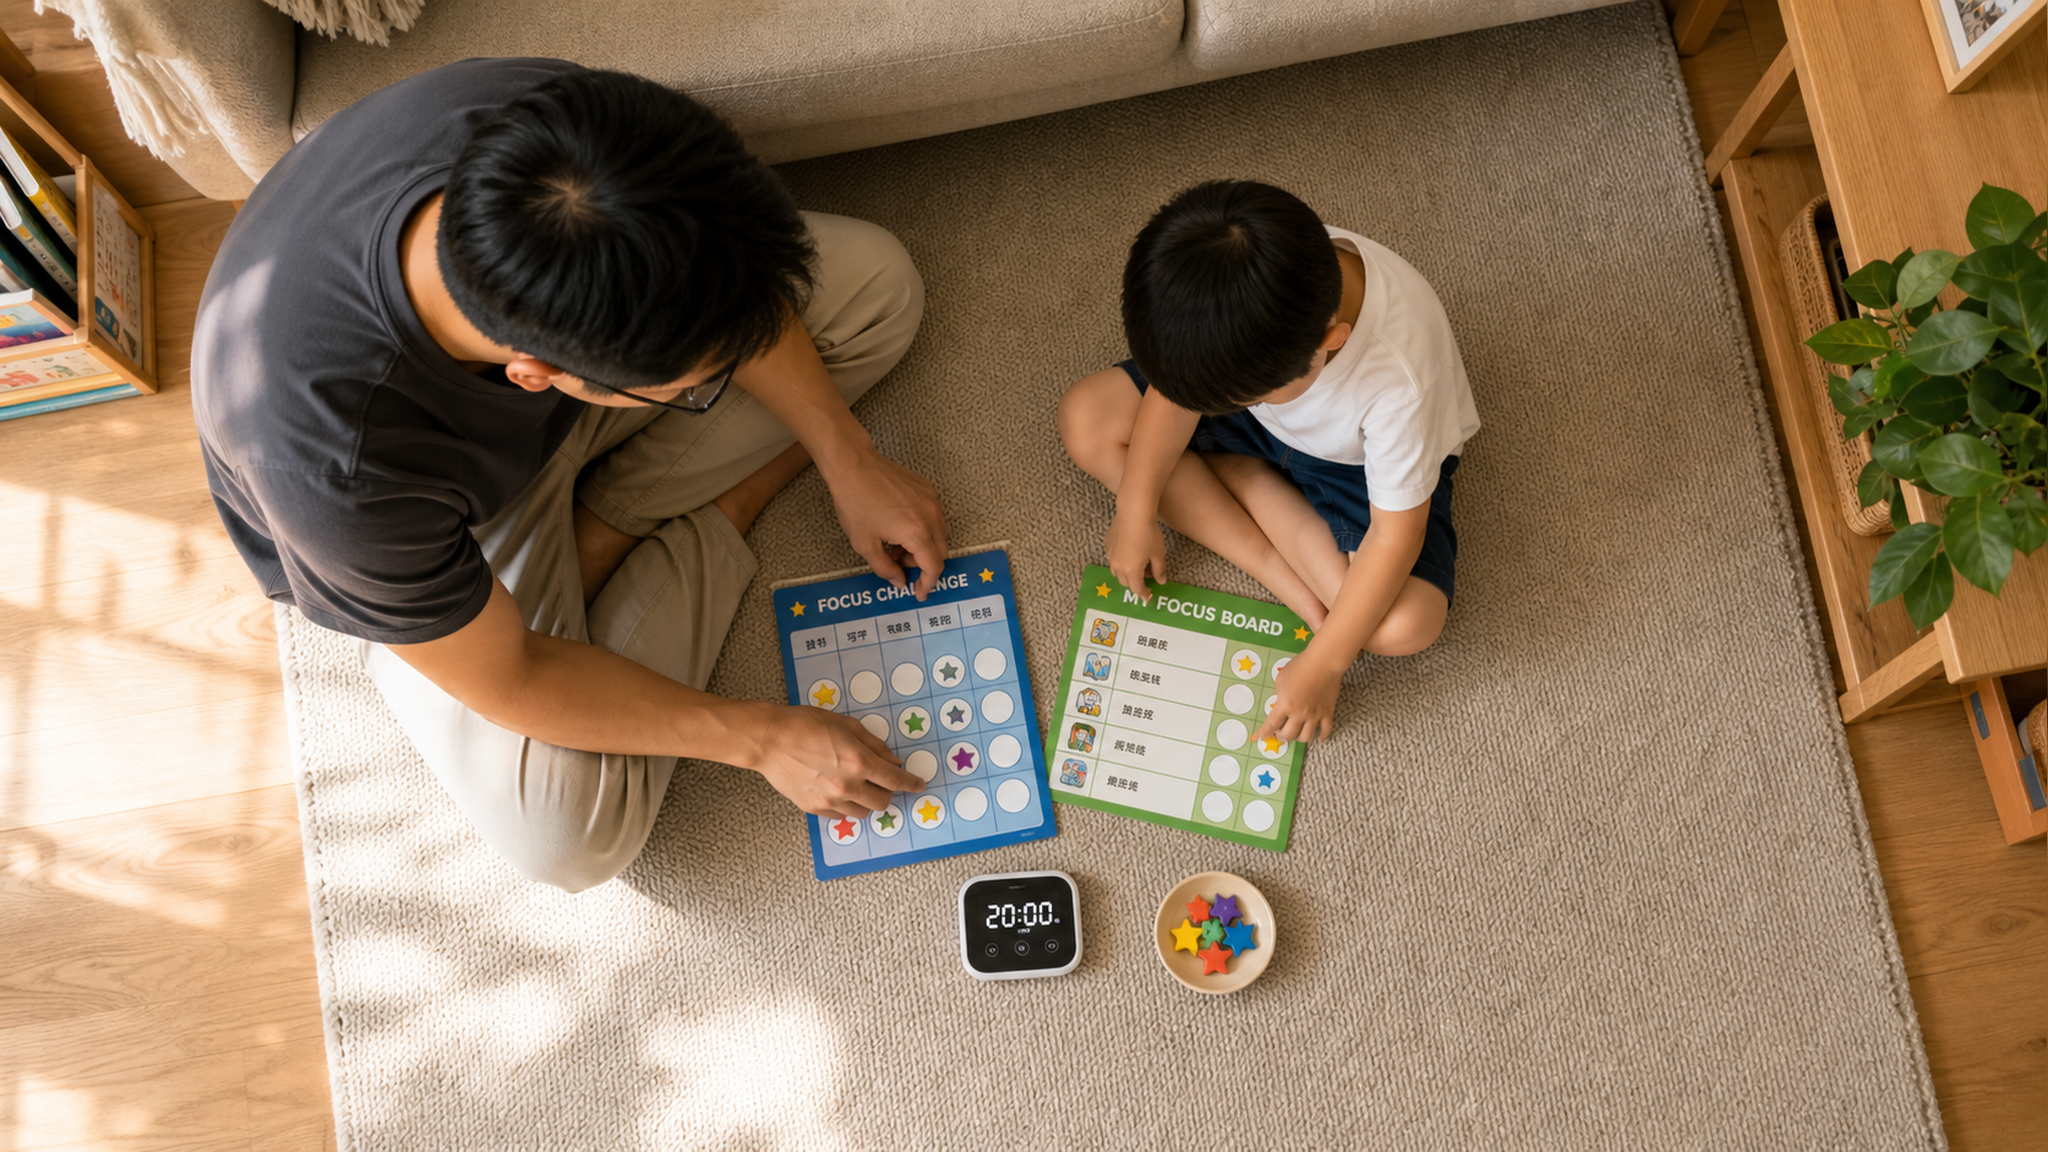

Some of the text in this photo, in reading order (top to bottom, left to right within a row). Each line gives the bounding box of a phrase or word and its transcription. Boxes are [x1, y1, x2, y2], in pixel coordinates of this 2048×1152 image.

[817, 573, 969, 613] FOCUS CHALNGE
[1156, 595, 1216, 622] FOCUS
[1220, 610, 1283, 637] BOARD
[985, 901, 1053, 929] 20:00
